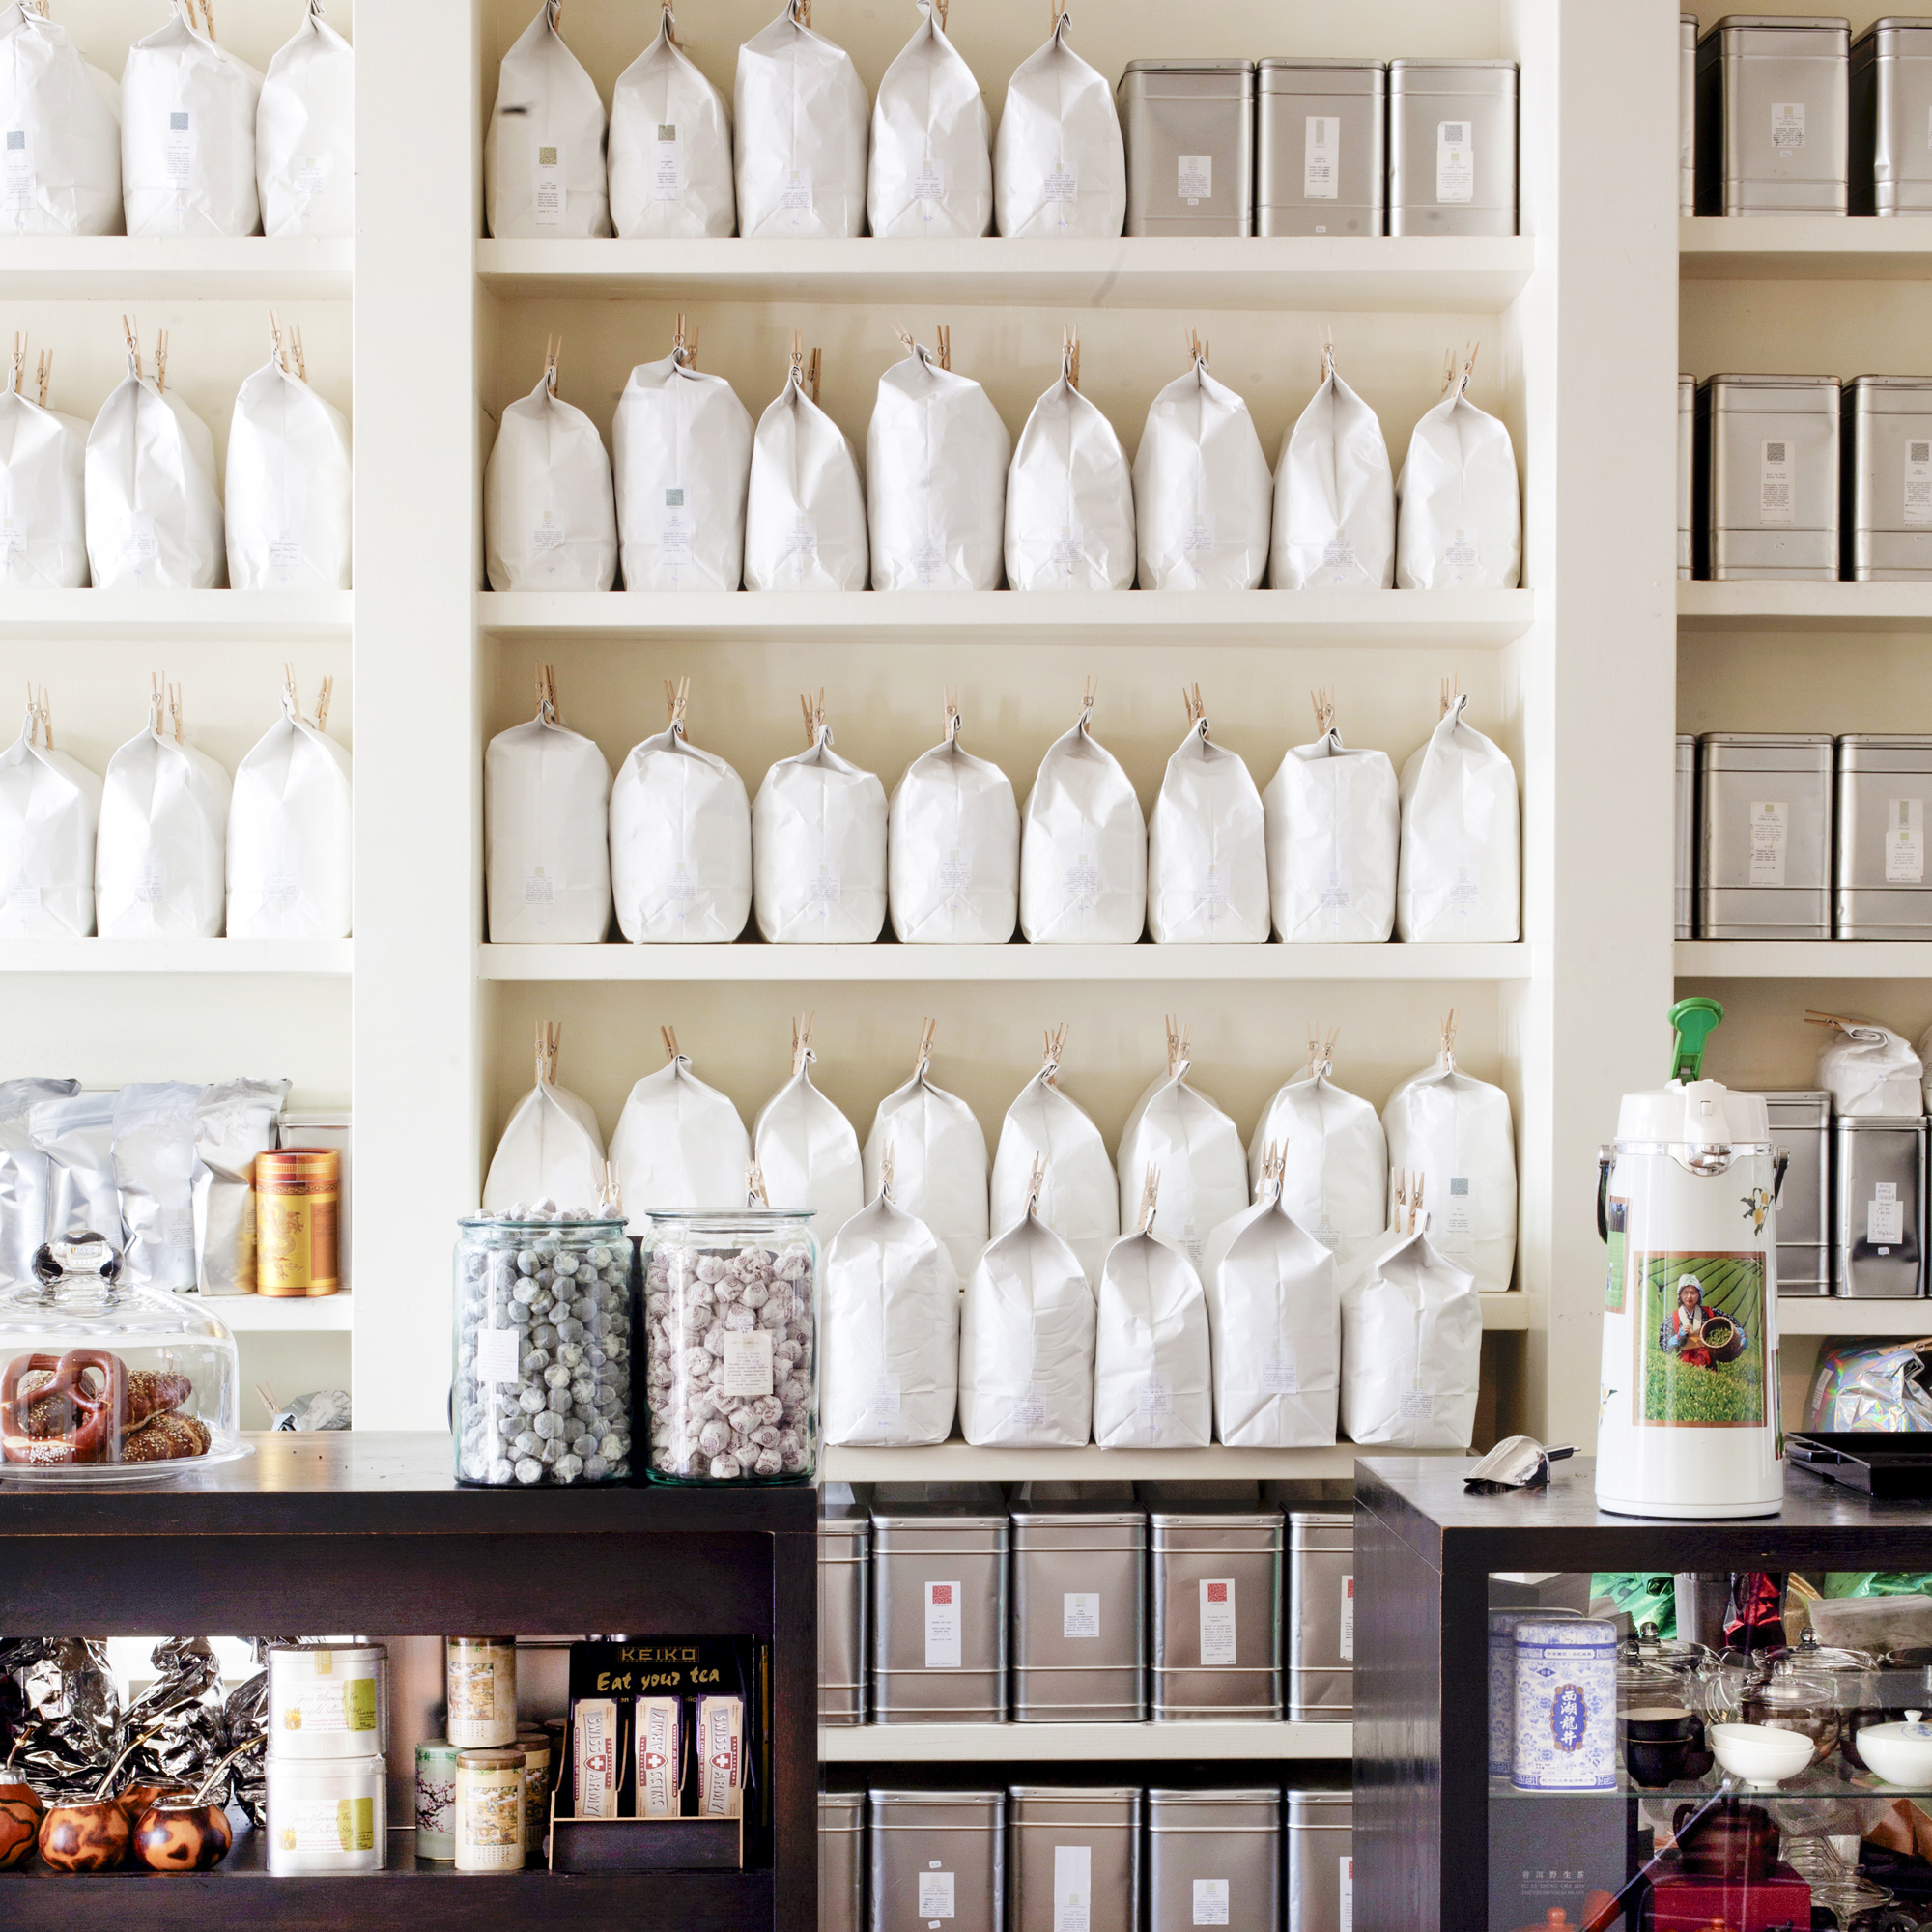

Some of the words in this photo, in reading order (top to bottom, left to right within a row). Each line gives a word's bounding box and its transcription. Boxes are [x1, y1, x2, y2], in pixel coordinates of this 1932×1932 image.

[622, 1648, 696, 1660] KEIKO
[597, 1671, 632, 1691] Eat
[640, 1671, 681, 1690] your
[690, 1666, 720, 1684] tea
[587, 1717, 602, 1753] SWISS
[650, 1712, 665, 1750] ARMY
[714, 1716, 727, 1751] SWISS
[586, 1774, 602, 1812] ARMY
[651, 1772, 665, 1807] SWISS
[712, 1772, 726, 1810] ARMY
